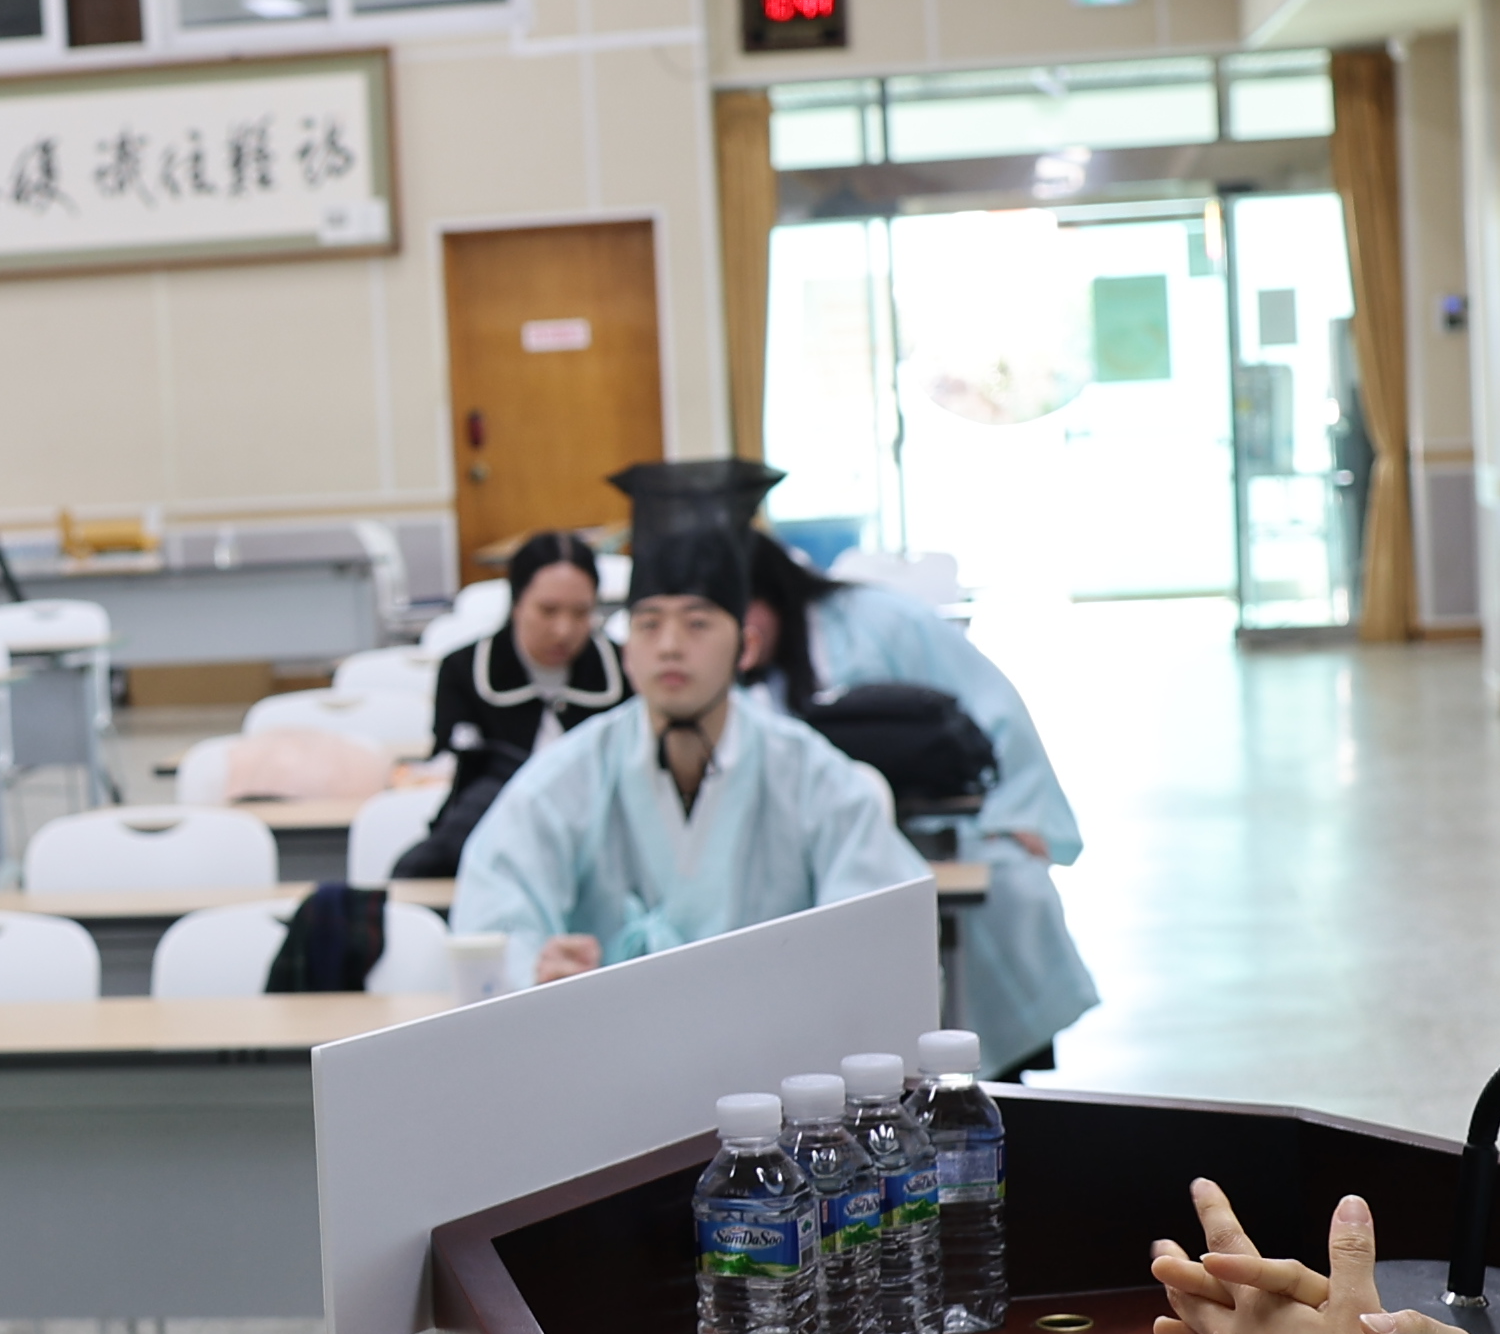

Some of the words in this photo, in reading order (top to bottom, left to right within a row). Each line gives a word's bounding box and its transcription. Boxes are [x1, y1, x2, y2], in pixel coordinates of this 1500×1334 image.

[906, 1172, 938, 1191] SamDaS
[846, 1197, 879, 1216] SamDaS
[715, 1228, 783, 1246] SamDaSoo
